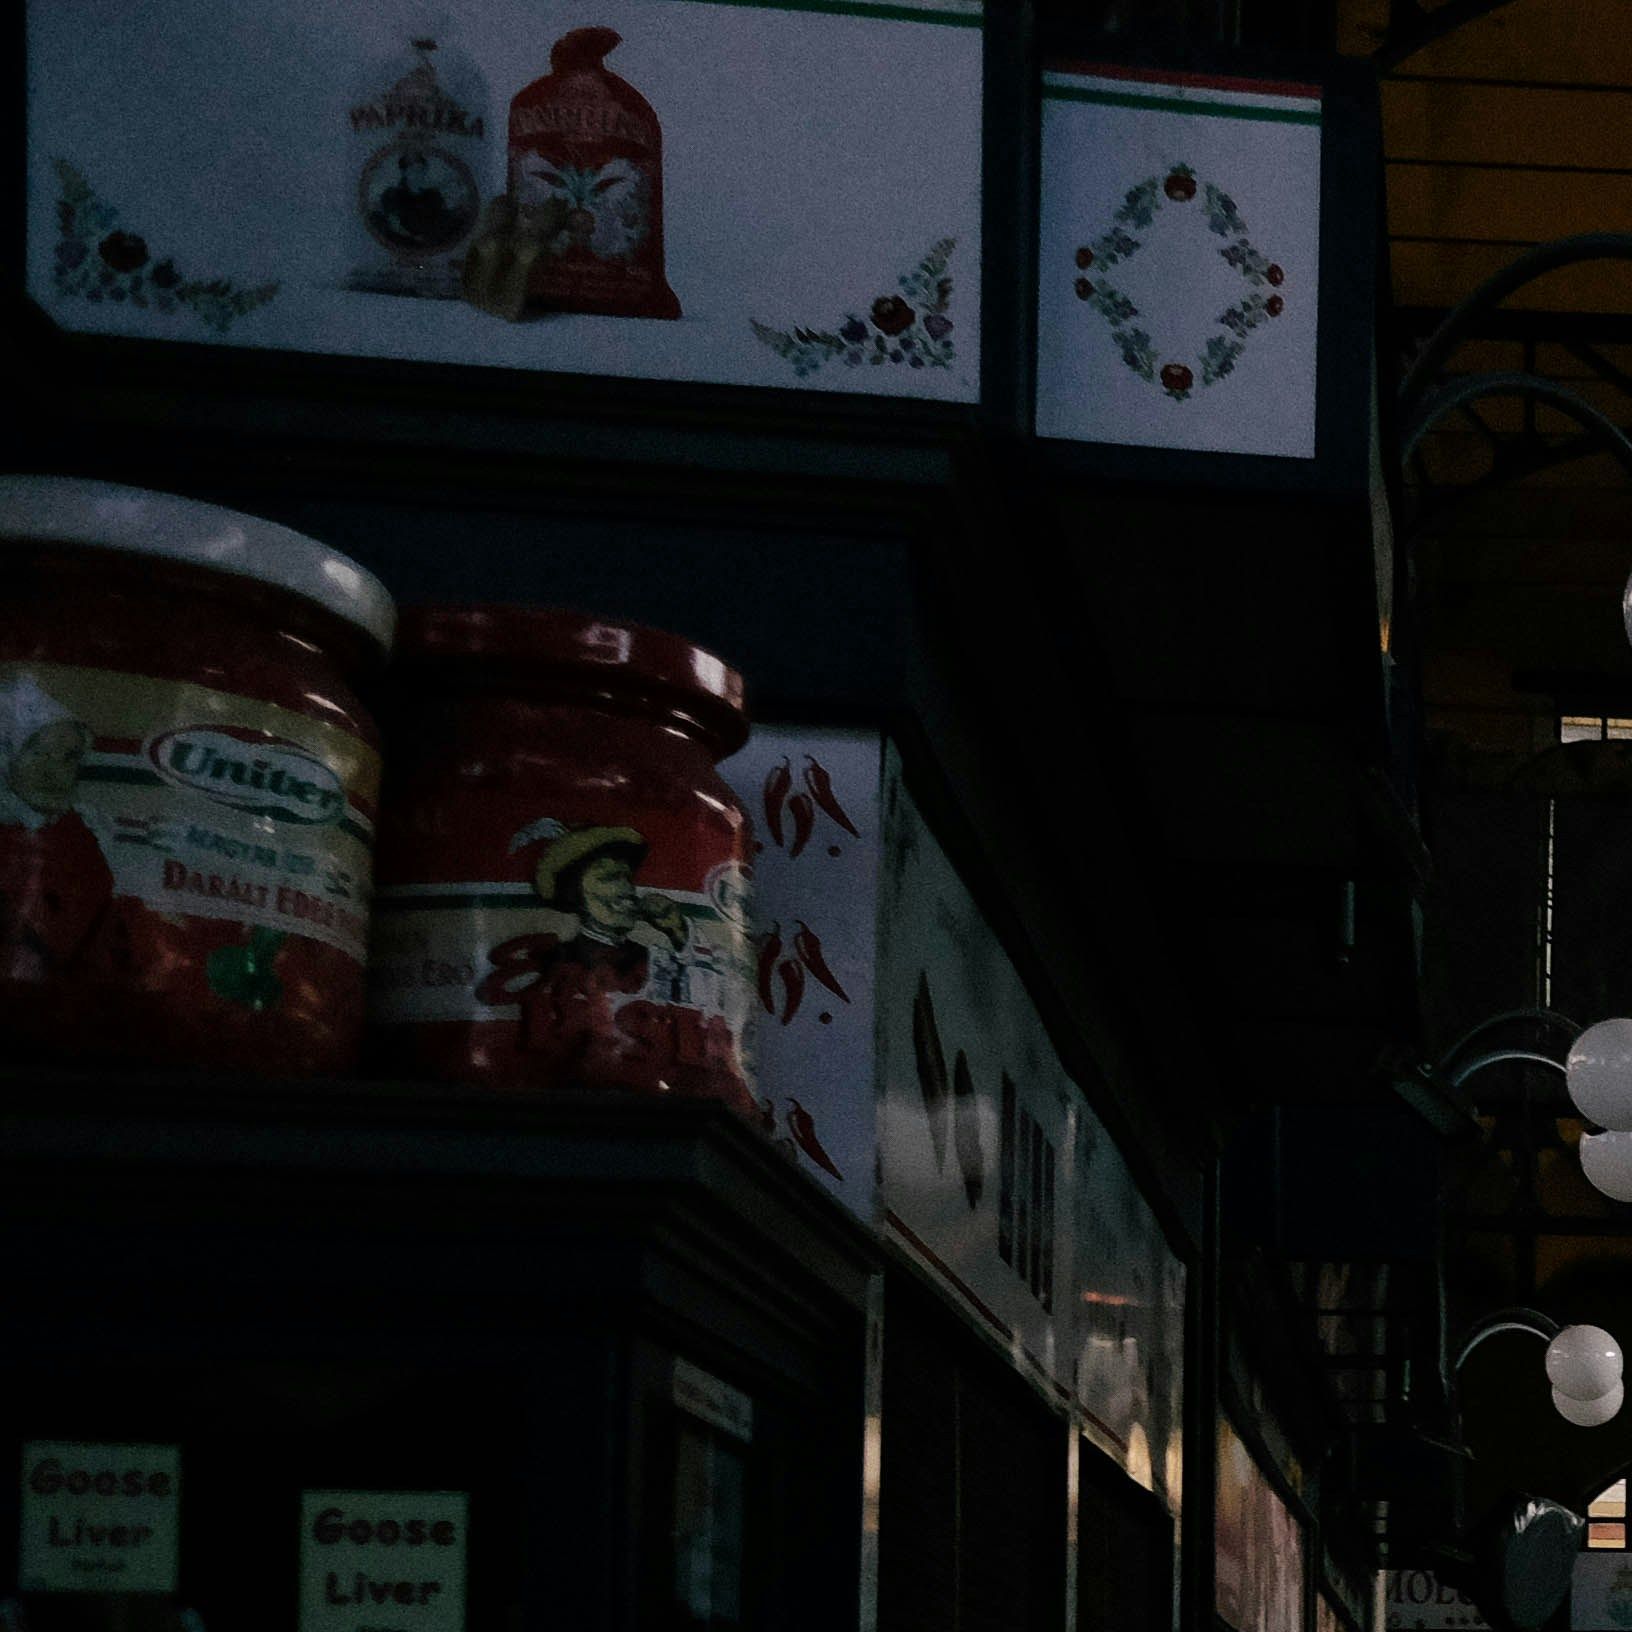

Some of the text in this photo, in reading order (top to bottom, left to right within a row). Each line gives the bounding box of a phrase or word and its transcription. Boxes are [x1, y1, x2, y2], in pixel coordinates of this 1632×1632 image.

[30, 1457, 172, 1498] Goose
[47, 1515, 153, 1548] Liver
[312, 1507, 456, 1546] Goose
[325, 1571, 443, 1606] Liver
